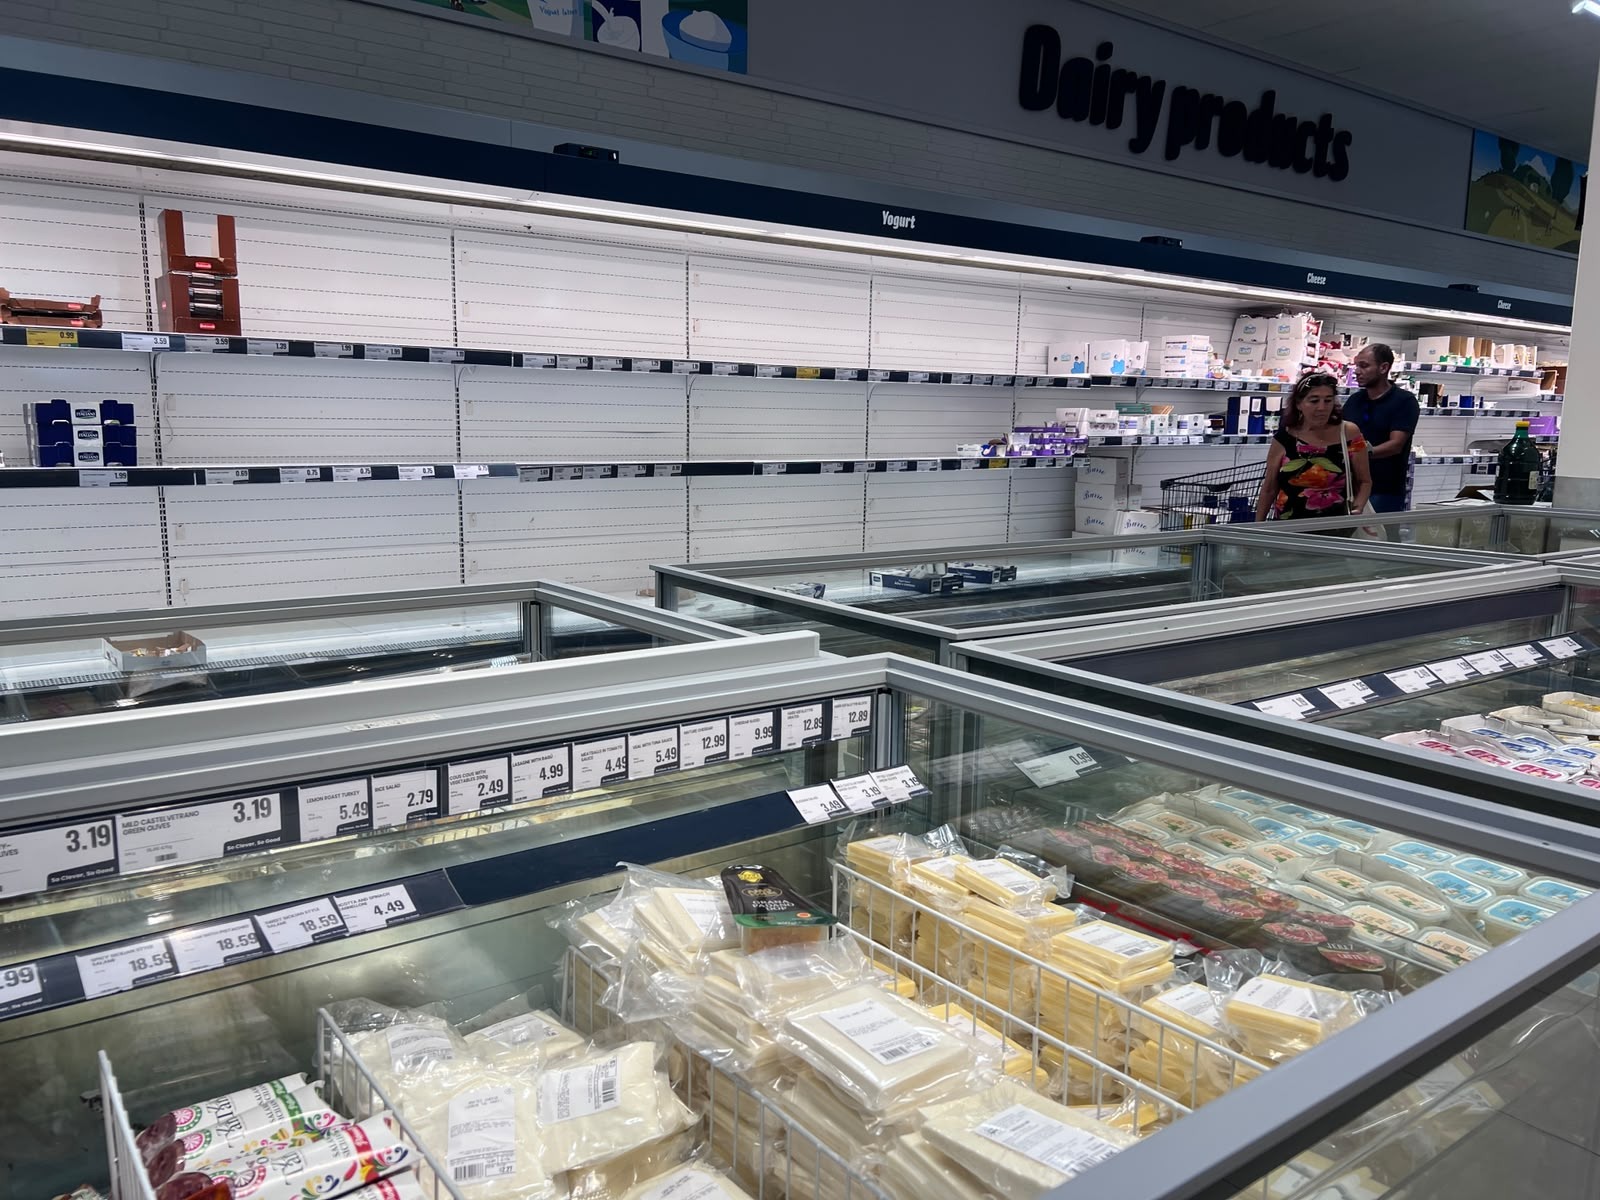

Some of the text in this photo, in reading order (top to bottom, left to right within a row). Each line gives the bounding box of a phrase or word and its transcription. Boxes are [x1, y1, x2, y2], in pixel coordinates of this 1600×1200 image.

[1019, 24, 1353, 181] Dairy products
[882, 210, 916, 230] Yogurt
[1306, 272, 1327, 285] Cheese
[59, 331, 75, 340] 0.99
[153, 337, 168, 345] 3.59
[215, 337, 229, 346] 3.59
[341, 344, 352, 352] 1.99
[390, 347, 401, 355] 1.99
[114, 472, 127, 480] 1.99
[803, 716, 823, 731] 12.89
[848, 709, 868, 723] 12.89
[754, 726, 773, 741] 9.99
[701, 733, 726, 750] 12.99
[512, 758, 531, 768] LASAGNE
[531, 756, 542, 764] WITH
[655, 747, 677, 763] 5.49
[1068, 751, 1093, 766] 0.99
[604, 755, 627, 772] 4.49
[475, 769, 487, 777] WITH
[539, 763, 564, 781] 4.99
[374, 783, 401, 794] RICE SALAD
[477, 778, 504, 797] 2.49
[901, 776, 921, 789] 3.19
[306, 790, 361, 805] LEMON ROAST TURKEY
[406, 788, 434, 808] 2.79
[861, 786, 882, 799] 3.19
[232, 797, 272, 823] 3.19
[339, 801, 369, 821] 5.49
[819, 799, 843, 813] 3.49
[121, 810, 200, 830] MILD CASTELVETRANO
[122, 821, 172, 837] GREEN OLIVES
[65, 823, 112, 854] 3.19
[0, 849, 19, 859] IVES
[338, 899, 357, 907] ICOTTA
[373, 899, 406, 916] 4.49
[299, 913, 339, 933] 18.59
[216, 932, 258, 951] 18.59
[128, 951, 172, 972] 18.59
